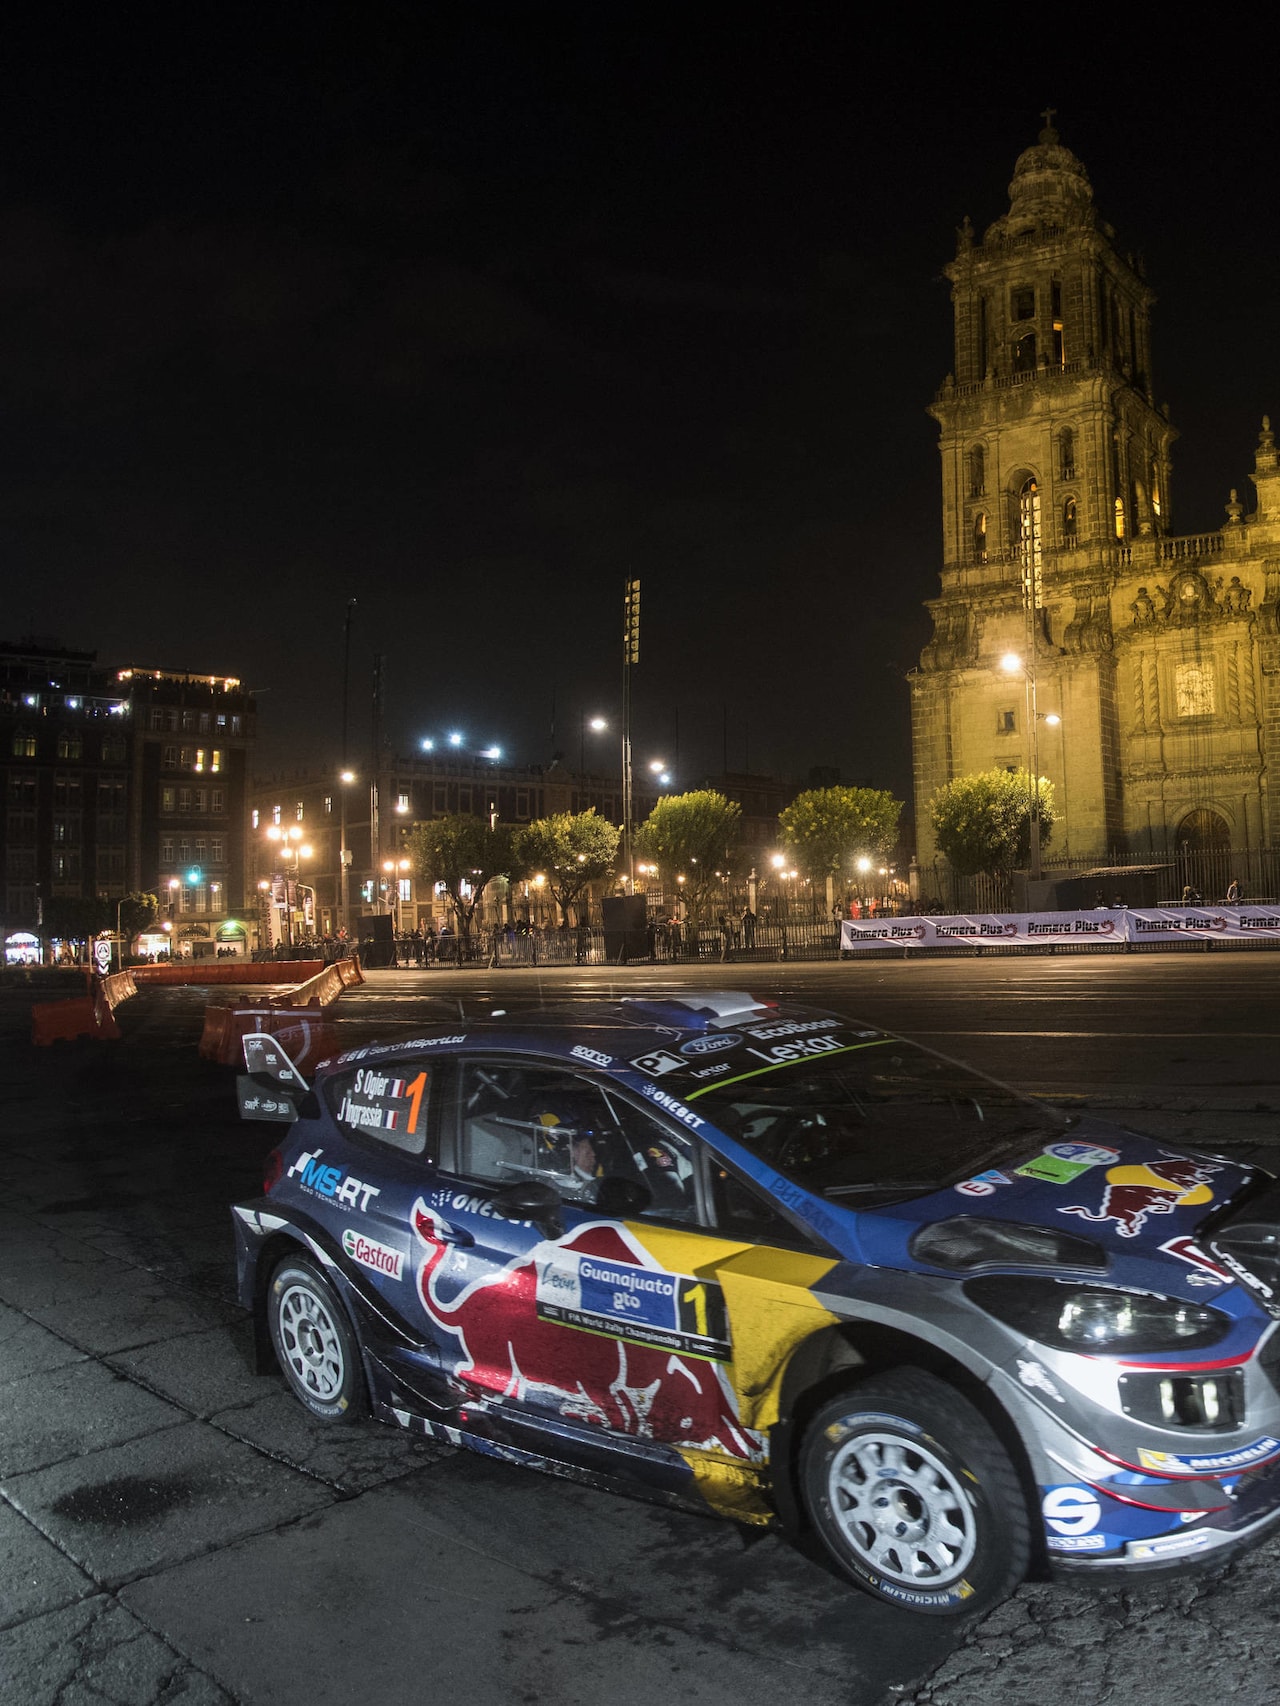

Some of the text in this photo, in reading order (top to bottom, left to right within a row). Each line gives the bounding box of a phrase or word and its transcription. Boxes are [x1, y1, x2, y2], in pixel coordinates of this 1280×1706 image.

[1027, 920, 1099, 934] Primera Plus
[1135, 917, 1211, 930] Primera Plus
[748, 1019, 844, 1040] EcoBoost
[572, 1045, 612, 1064] sparco
[692, 1039, 735, 1052] Ford
[745, 1035, 845, 1064] Lexar
[690, 1062, 731, 1078] Lexar
[354, 1069, 389, 1100] S Ogier
[337, 1097, 383, 1129] J Ingrassia
[406, 1072, 428, 1134] 1
[653, 1091, 705, 1128] ONEBET
[356, 1238, 399, 1276] Castrol
[579, 1262, 674, 1296] Guanajuato
[613, 1292, 641, 1310] gto
[683, 1283, 708, 1336] 1
[568, 1312, 581, 1324] FIA
[1190, 1438, 1279, 1467] MICHELIN
[882, 1584, 950, 1606] MICHELIN
